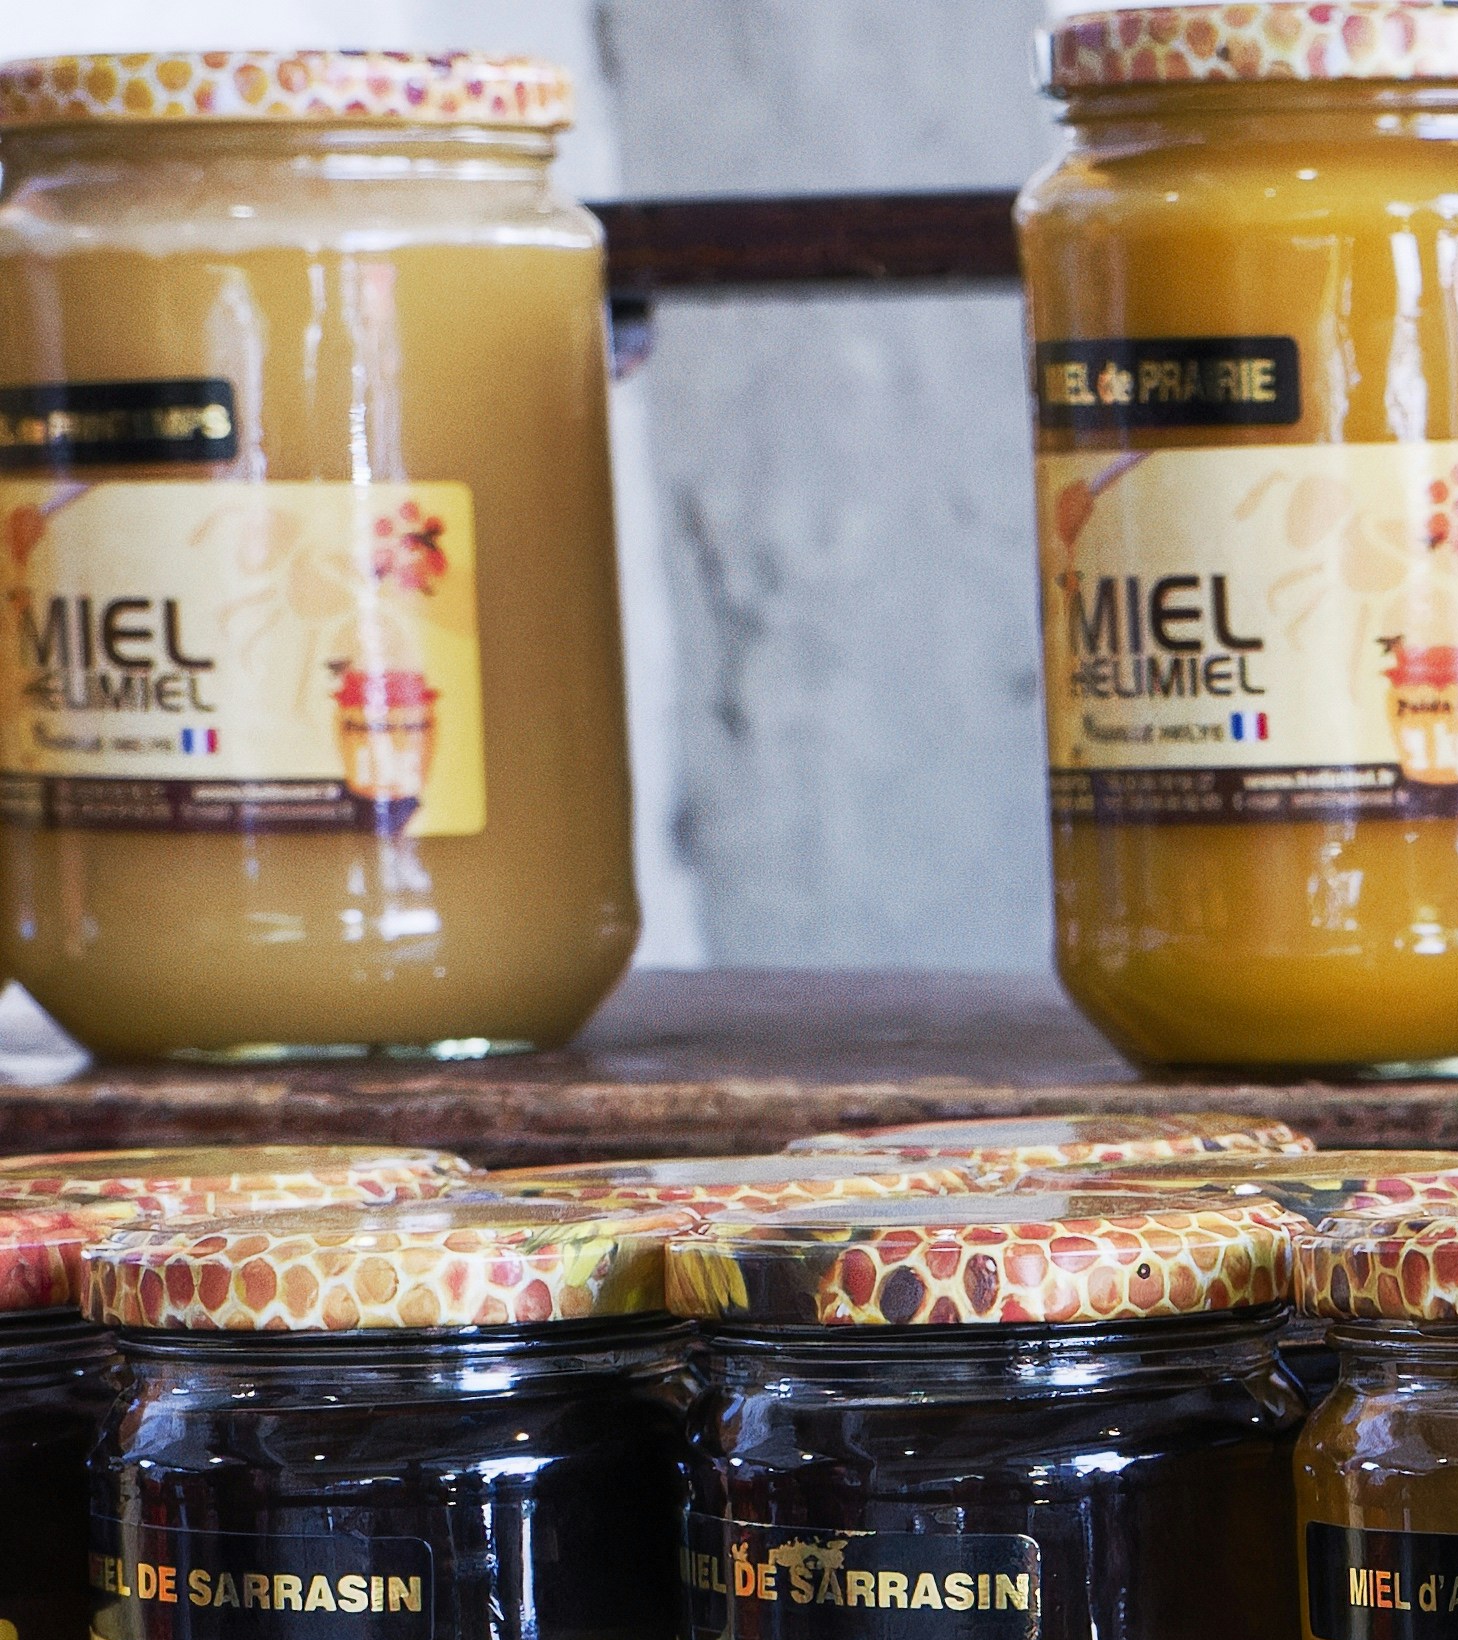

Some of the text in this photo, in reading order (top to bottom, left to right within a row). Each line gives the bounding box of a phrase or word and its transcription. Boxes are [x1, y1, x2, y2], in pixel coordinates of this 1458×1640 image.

[1073, 576, 1263, 655] MIEL
[137, 1562, 177, 1602] DE
[189, 1568, 421, 1612] SARRASIN
[734, 1561, 777, 1600] DE
[790, 1566, 1030, 1610] SARRASIN
[1349, 1568, 1409, 1609] MIEL
